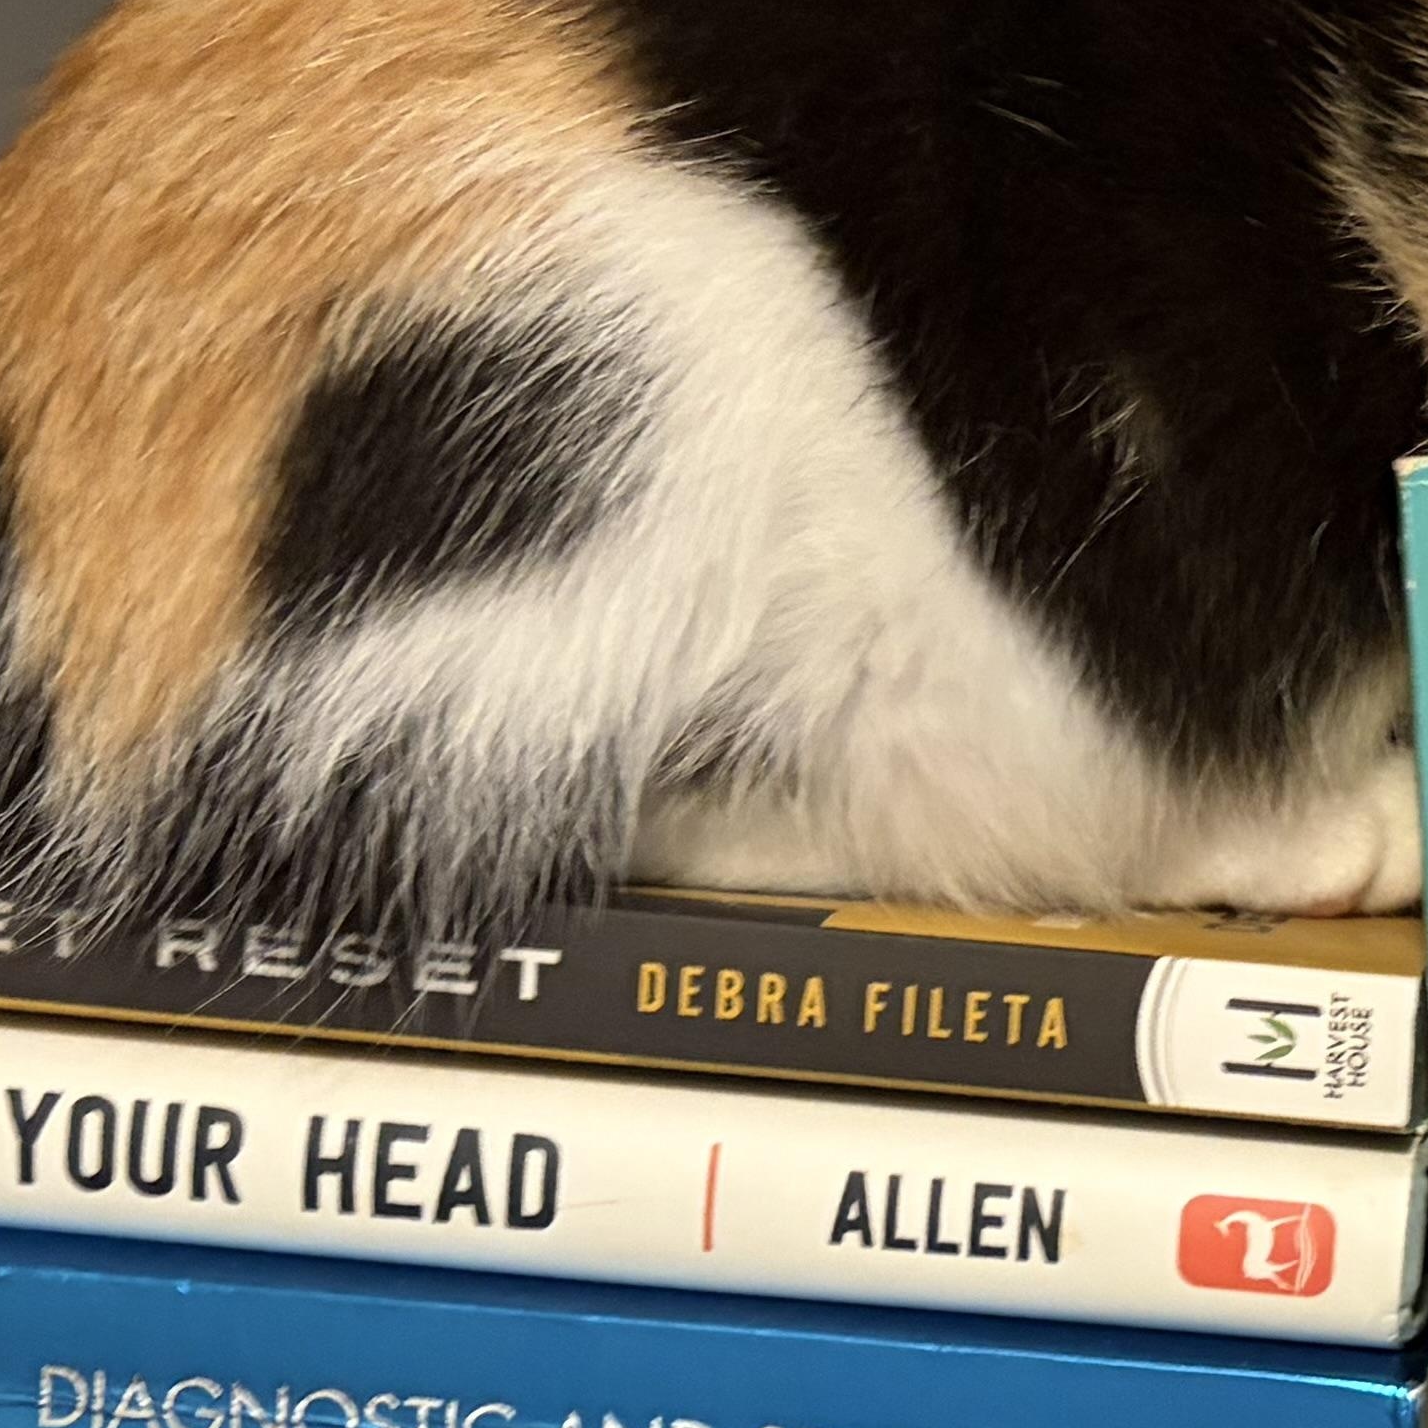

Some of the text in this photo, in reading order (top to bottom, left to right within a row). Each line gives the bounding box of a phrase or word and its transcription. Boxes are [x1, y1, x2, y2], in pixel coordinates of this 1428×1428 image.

[156, 922, 561, 1002] RESET
[636, 962, 1069, 1051] DEBRA FILETA
[1323, 992, 1353, 1100] HARVEST
[1346, 1006, 1374, 1089] HOUSE
[5, 1088, 244, 1204] YOUR
[302, 1114, 560, 1231] HEAD
[829, 1170, 1067, 1265] ALLEN
